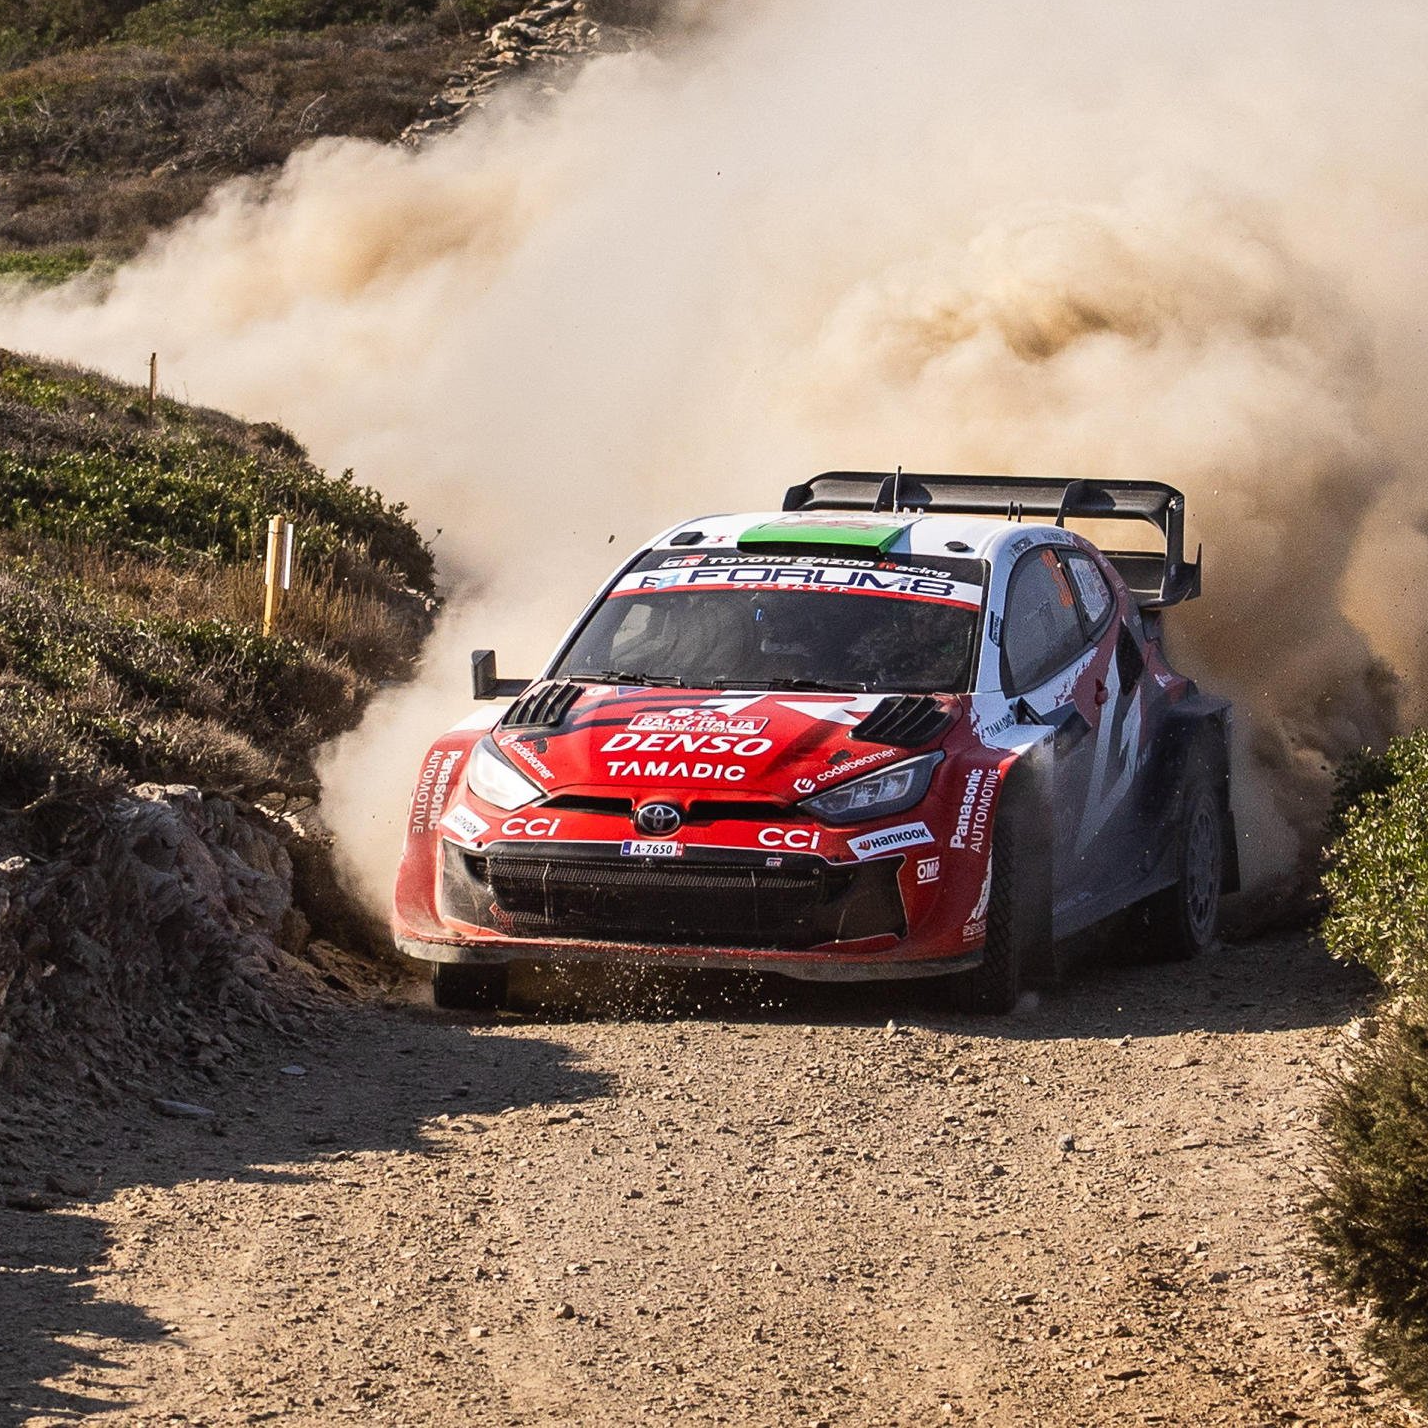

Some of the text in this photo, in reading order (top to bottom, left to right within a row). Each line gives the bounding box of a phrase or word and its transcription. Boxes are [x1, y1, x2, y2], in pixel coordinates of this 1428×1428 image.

[661, 555, 952, 579] GR TOYOTA GAZOO Racing
[688, 568, 956, 597] FORUM8
[638, 717, 692, 728] RALLY
[696, 720, 756, 730] ITALIA
[985, 714, 1015, 738] TAMADIC
[601, 733, 773, 757] DENSO
[606, 761, 746, 781] TAMADIC
[816, 748, 898, 783] codebeamer
[411, 750, 444, 834] AUTOMOTIVE
[427, 750, 463, 831] Panasonic
[950, 768, 983, 850] Panasonic
[969, 768, 1002, 854] AUTOMOTIVE
[633, 843, 673, 855] A-7650
[917, 859, 940, 880] OMP
